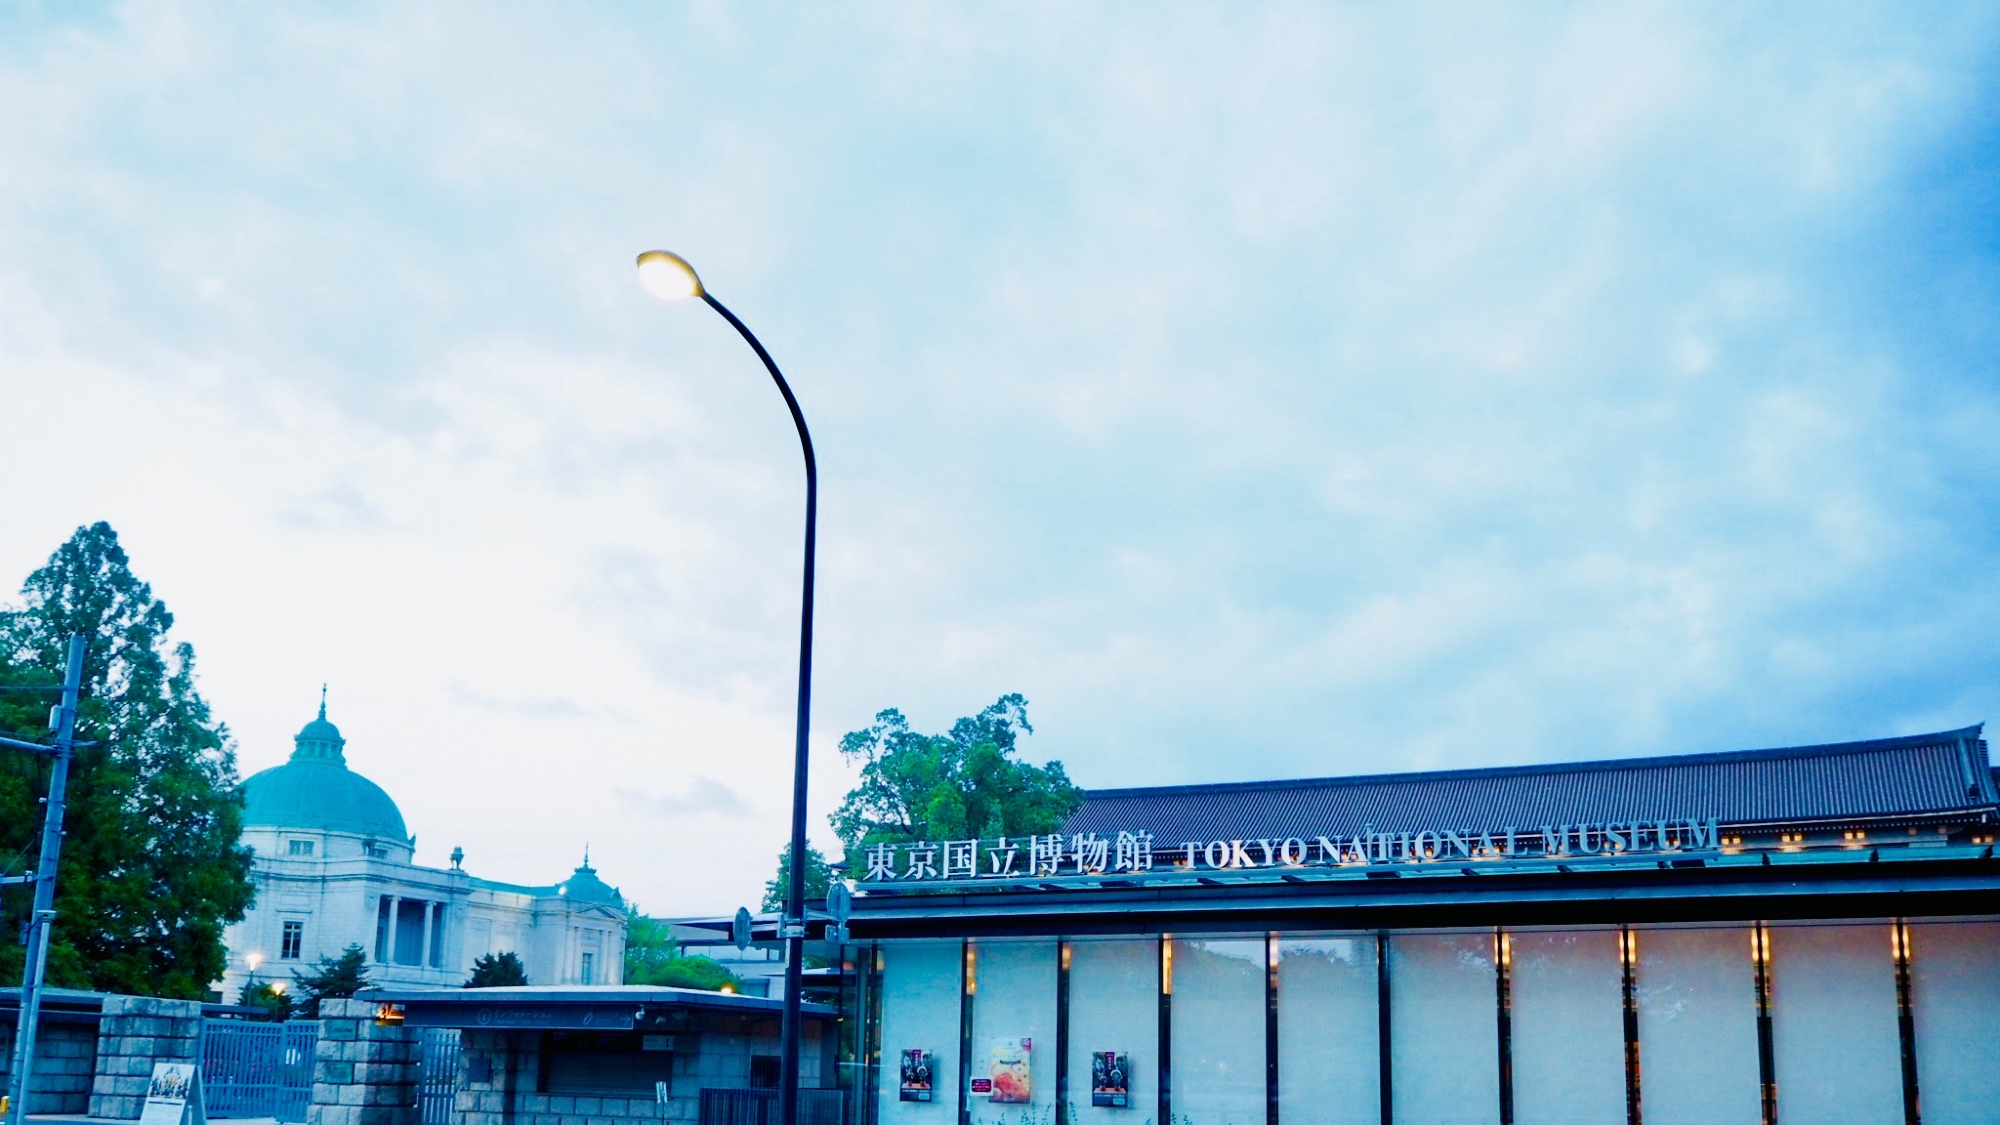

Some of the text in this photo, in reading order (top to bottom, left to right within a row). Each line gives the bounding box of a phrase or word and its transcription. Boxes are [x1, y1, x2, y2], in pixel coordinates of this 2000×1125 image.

[862, 830, 1153, 880] 東京国立博物館
[1180, 817, 1721, 869] TOKYO NATIONAL MUSEUM
